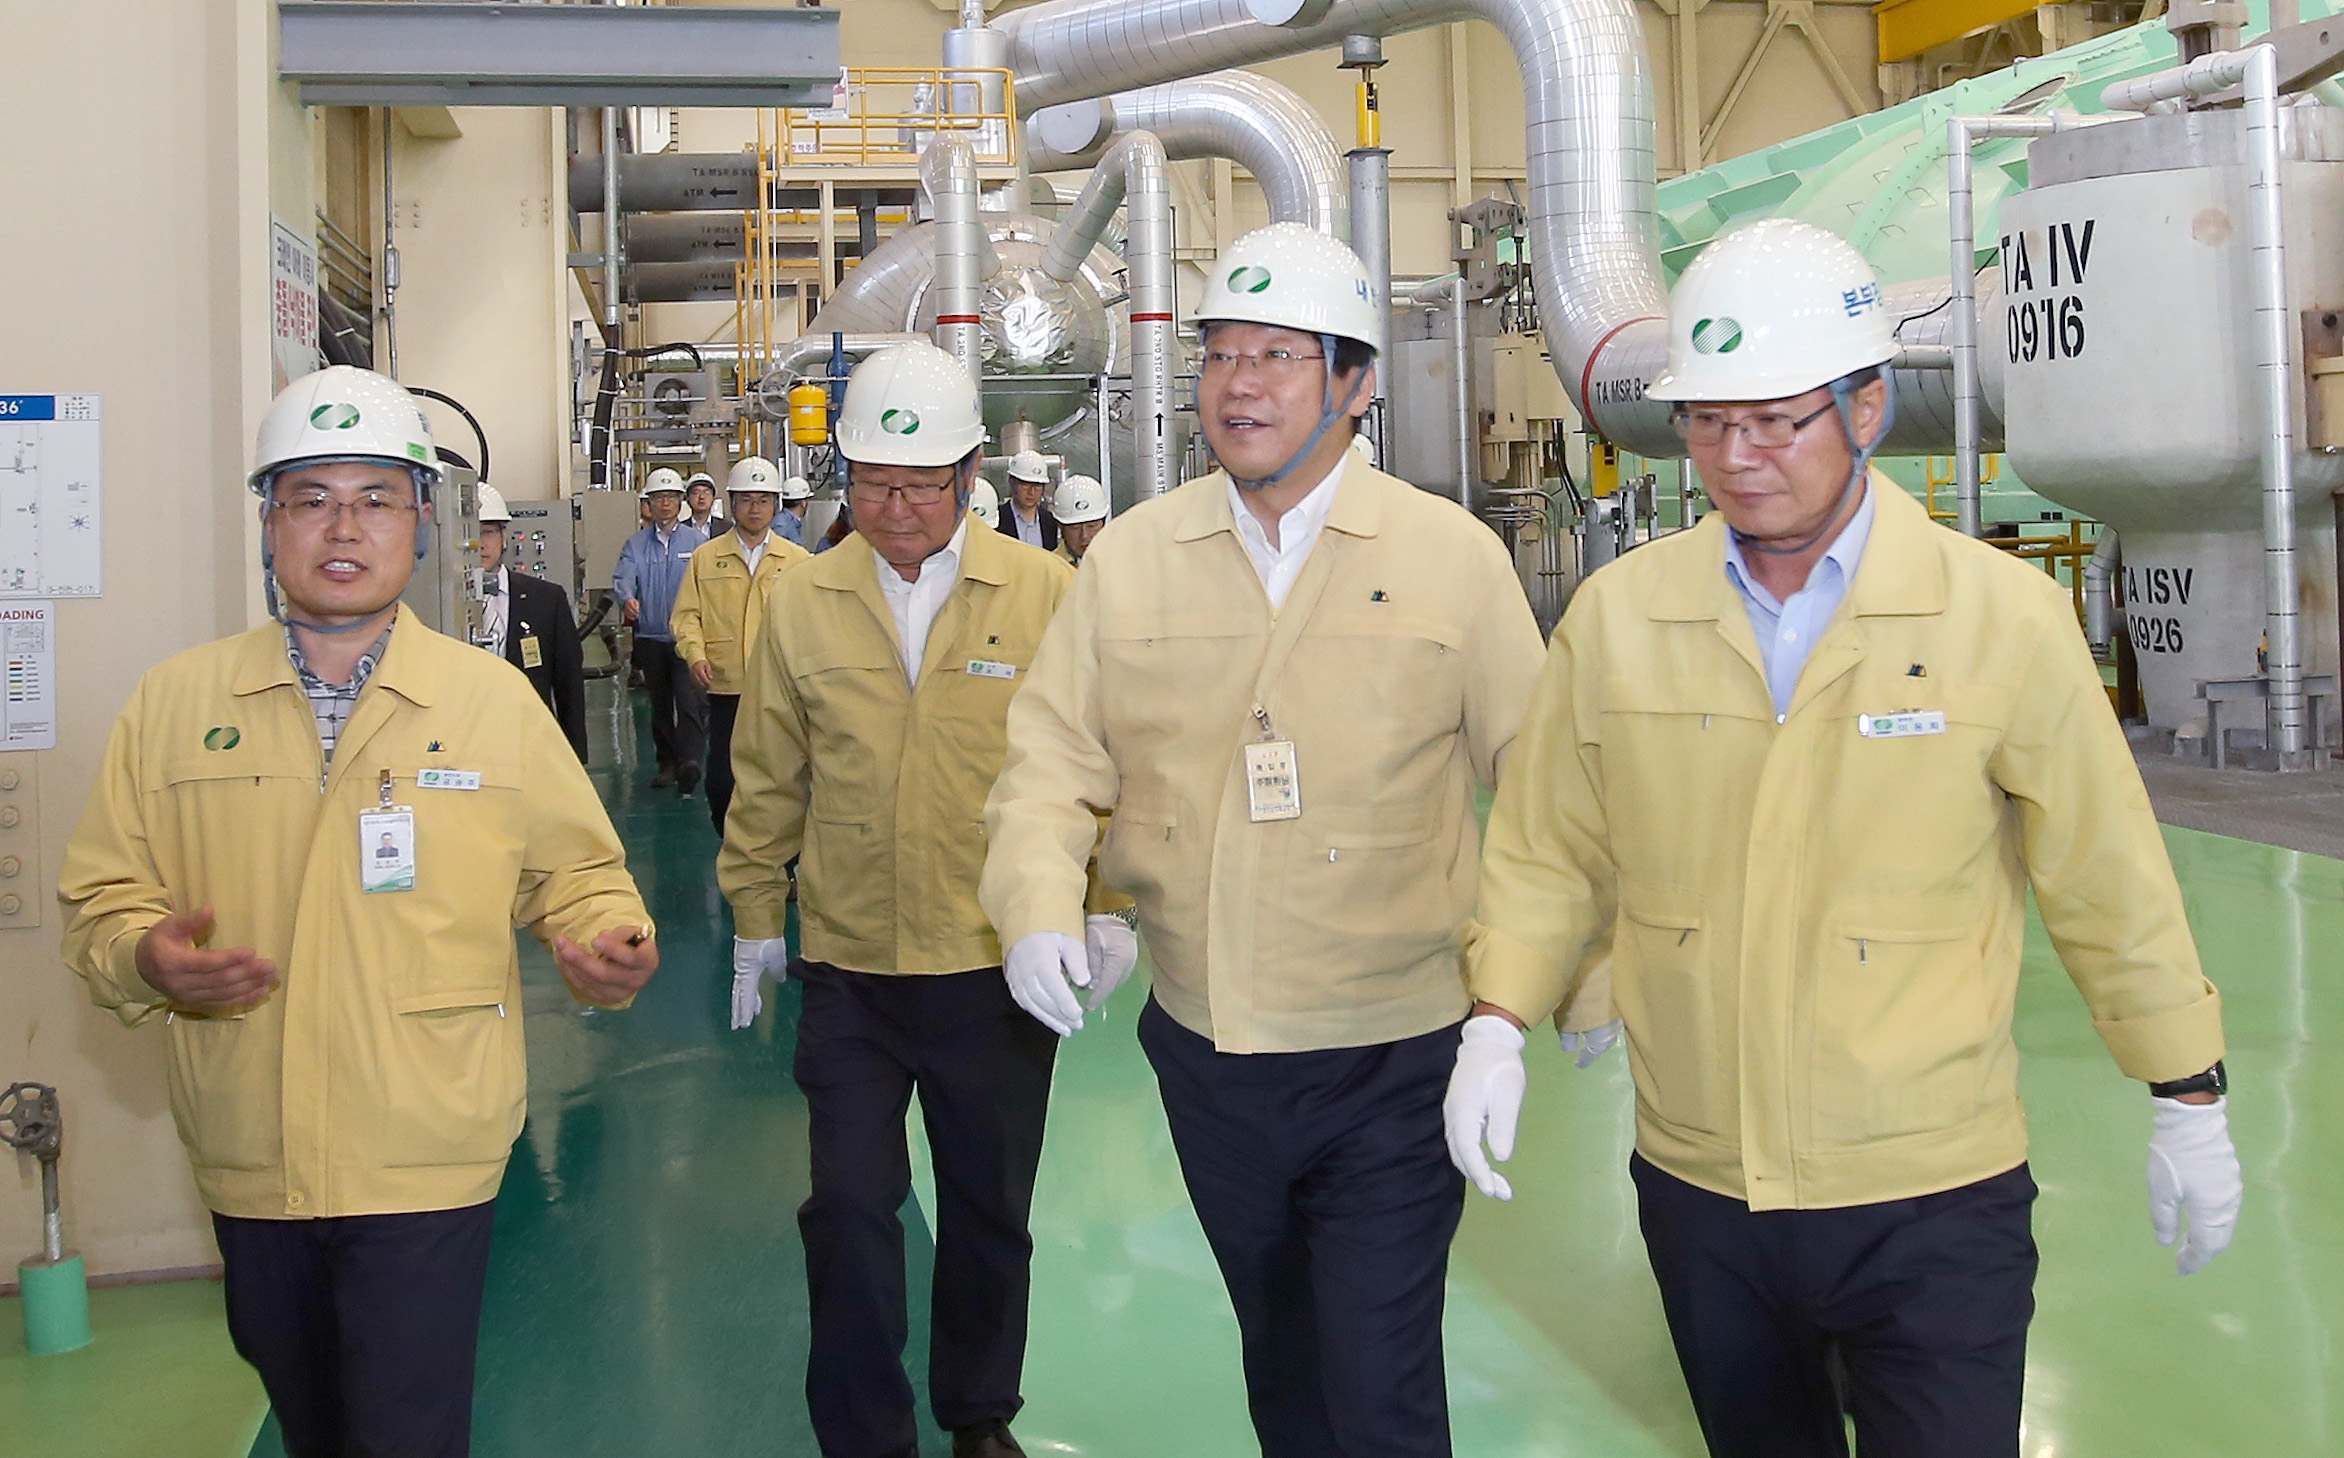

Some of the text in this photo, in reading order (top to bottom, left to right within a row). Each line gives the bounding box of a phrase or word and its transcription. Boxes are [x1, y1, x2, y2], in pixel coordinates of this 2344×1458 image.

[683, 188, 704, 197] ATM
[2001, 219, 2095, 295] TA IV
[957, 326, 966, 338] TA
[1154, 324, 1162, 336] TA
[2008, 295, 2085, 364] 0916
[1596, 377, 1642, 404] TA MSR B
[2122, 566, 2193, 605] TA ISV
[0, 609, 45, 621] ADING
[2129, 614, 2183, 653] 0926
